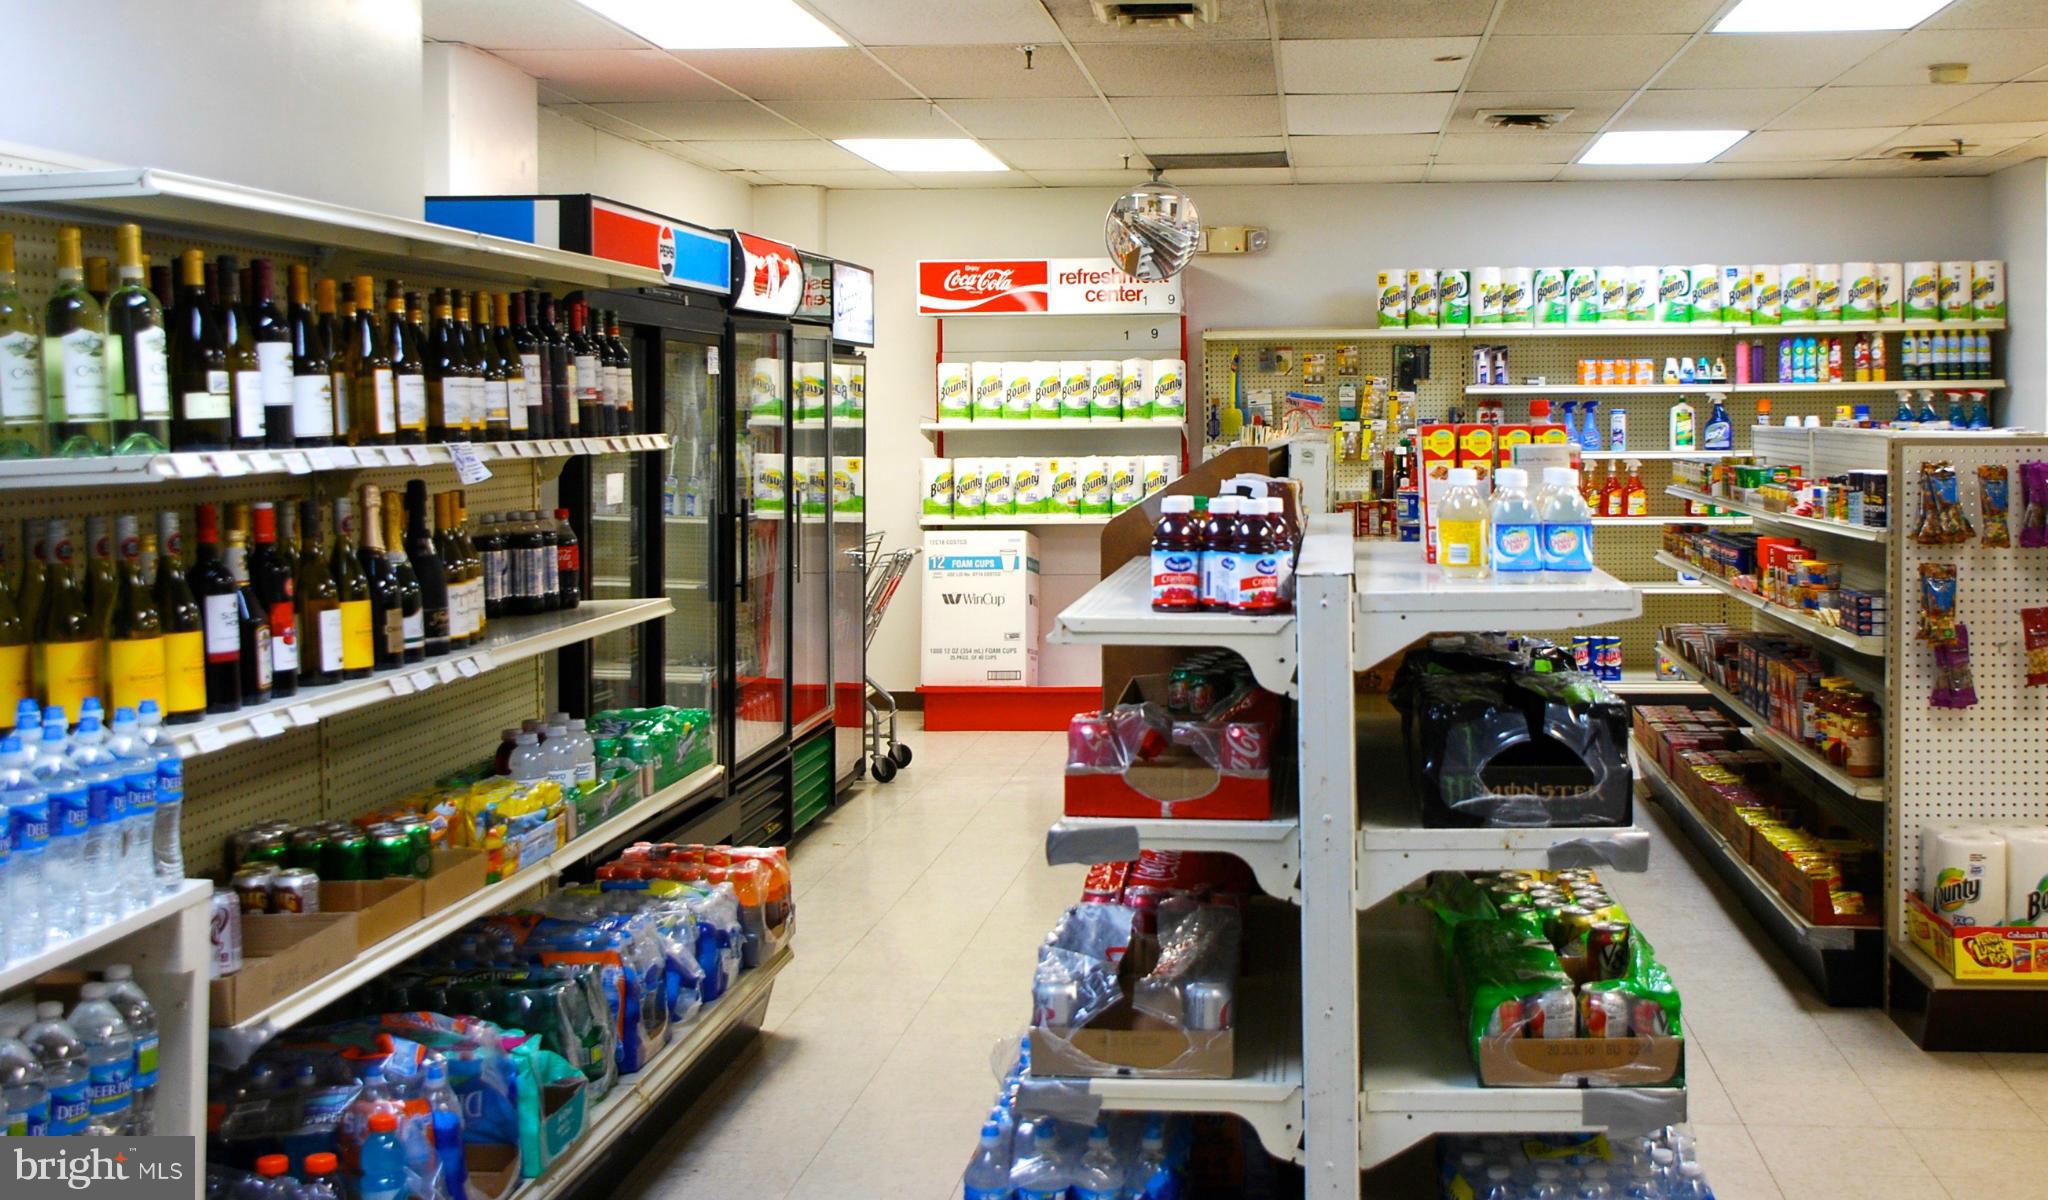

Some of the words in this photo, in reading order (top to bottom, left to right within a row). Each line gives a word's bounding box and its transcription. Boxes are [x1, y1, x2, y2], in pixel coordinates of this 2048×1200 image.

[943, 269, 1015, 292] Coca-Cola
[1085, 286, 1143, 302] center
[1151, 329, 1159, 338] 9
[1155, 378, 1182, 400] Bounty
[956, 477, 982, 499] Bounty
[932, 556, 945, 569] 12
[952, 560, 972, 568] FOAM
[975, 560, 994, 568] CUPS
[963, 593, 1005, 606] WinCup
